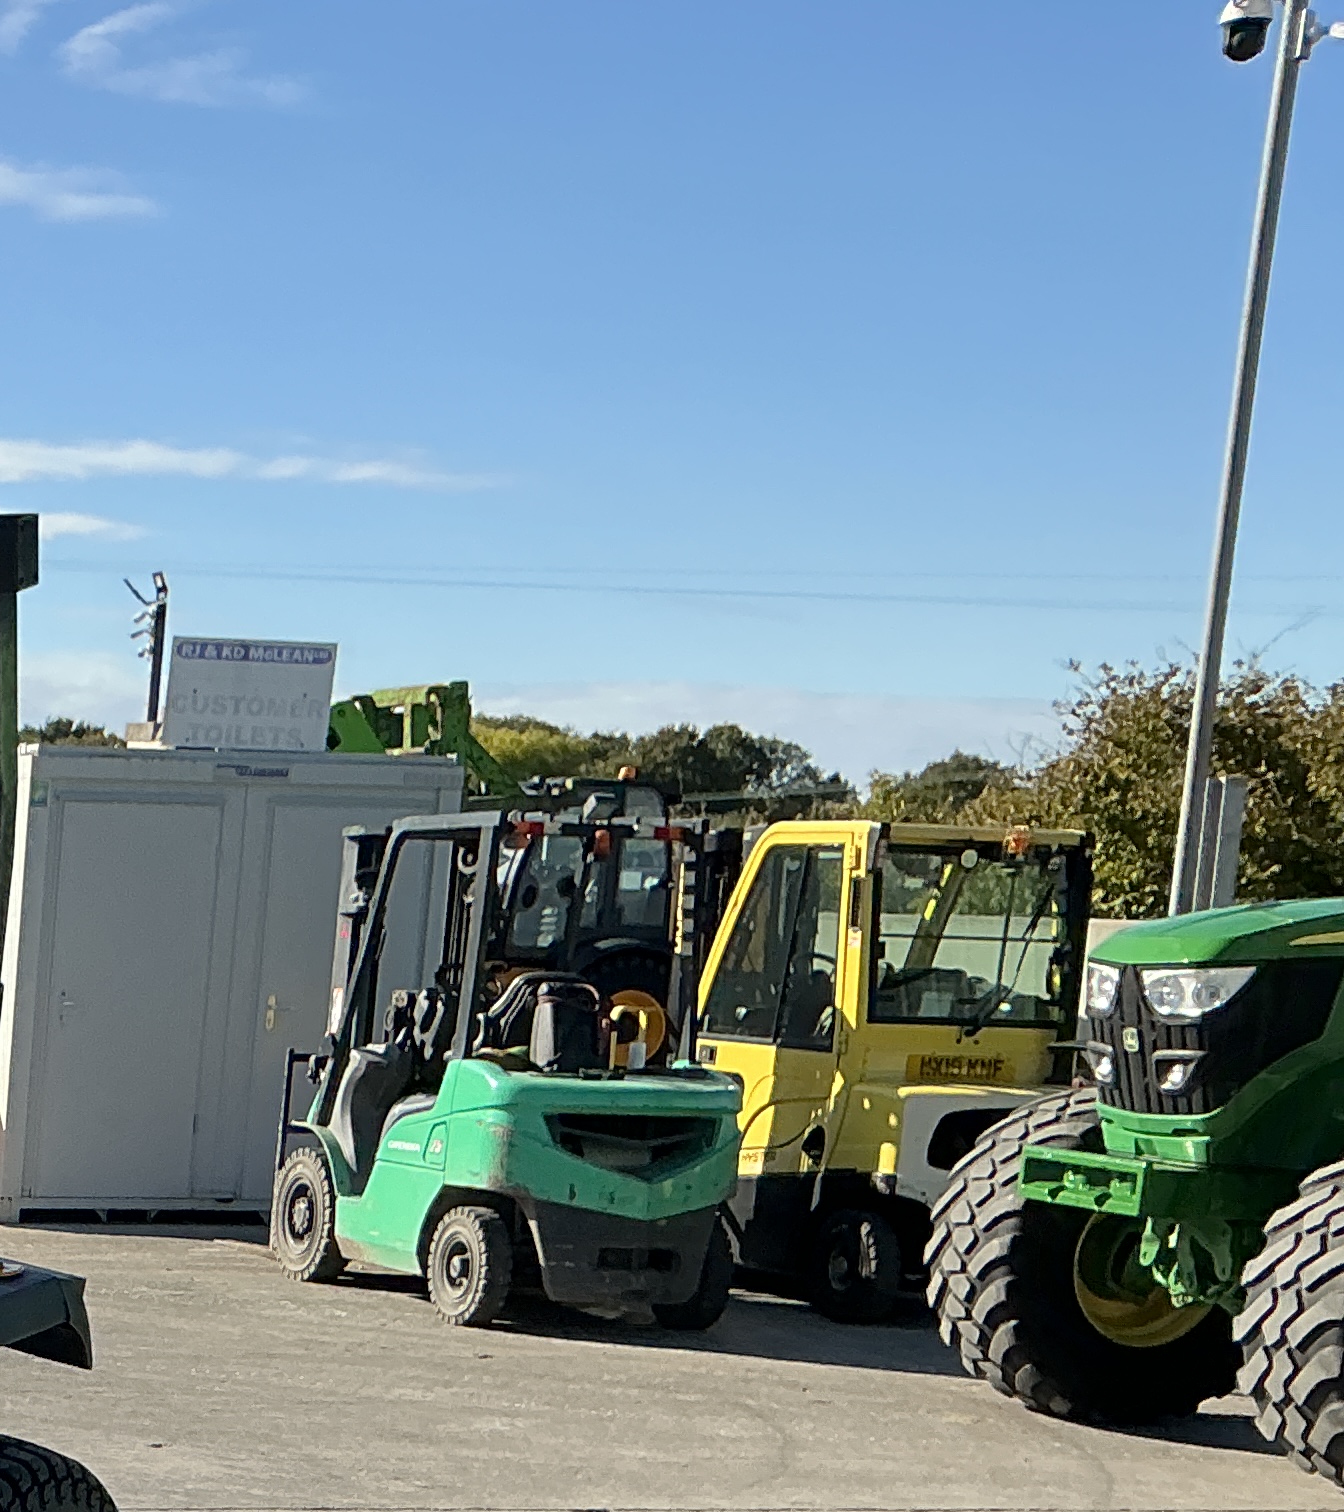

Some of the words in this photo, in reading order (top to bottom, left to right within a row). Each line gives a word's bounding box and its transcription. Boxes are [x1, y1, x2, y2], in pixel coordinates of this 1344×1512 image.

[181, 643, 200, 657] RJ
[207, 645, 218, 659] &
[221, 645, 246, 660] KD
[171, 694, 323, 719] CUSTOMER
[189, 721, 303, 747] TOILETS
